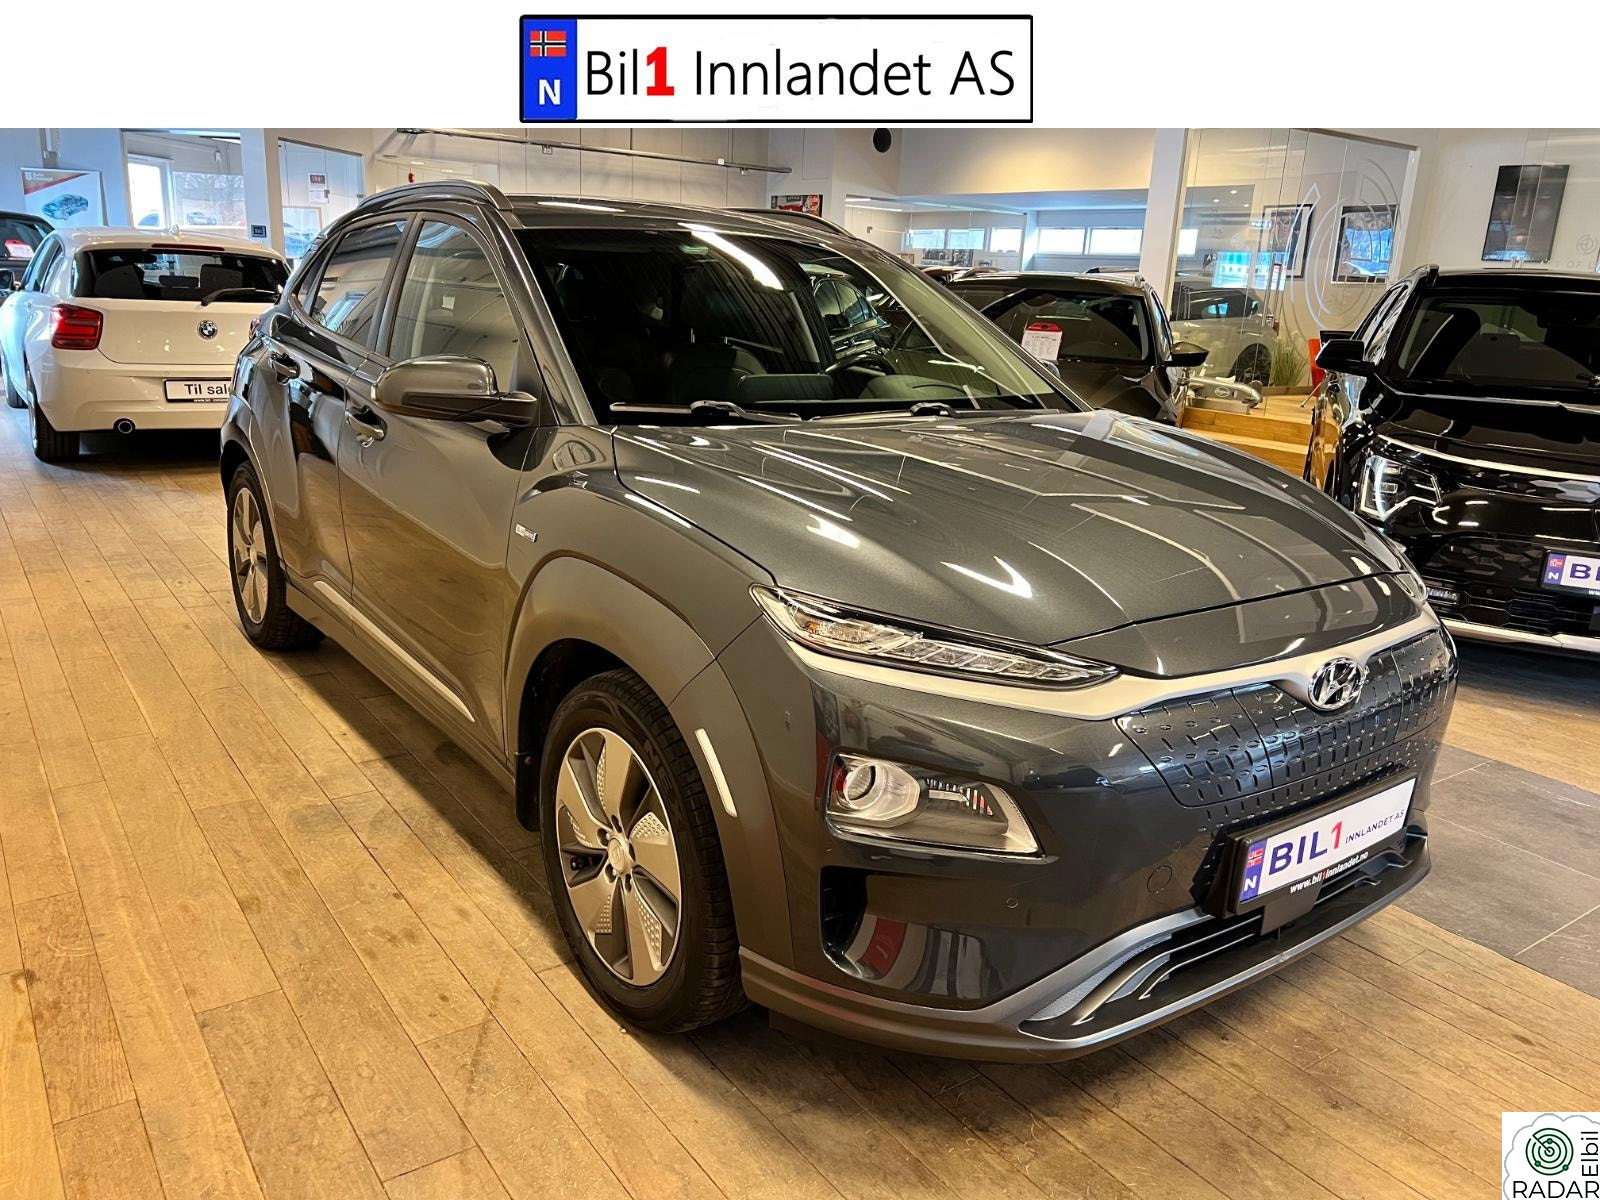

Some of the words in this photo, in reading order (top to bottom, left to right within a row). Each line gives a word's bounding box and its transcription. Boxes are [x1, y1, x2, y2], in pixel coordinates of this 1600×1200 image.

[184, 384, 202, 394] Til
[1345, 815, 1394, 844] INNLANDET
[1394, 809, 1405, 821] AS
[1243, 875, 1258, 892] N
[1290, 851, 1369, 894] www.bil1innlandet.no
